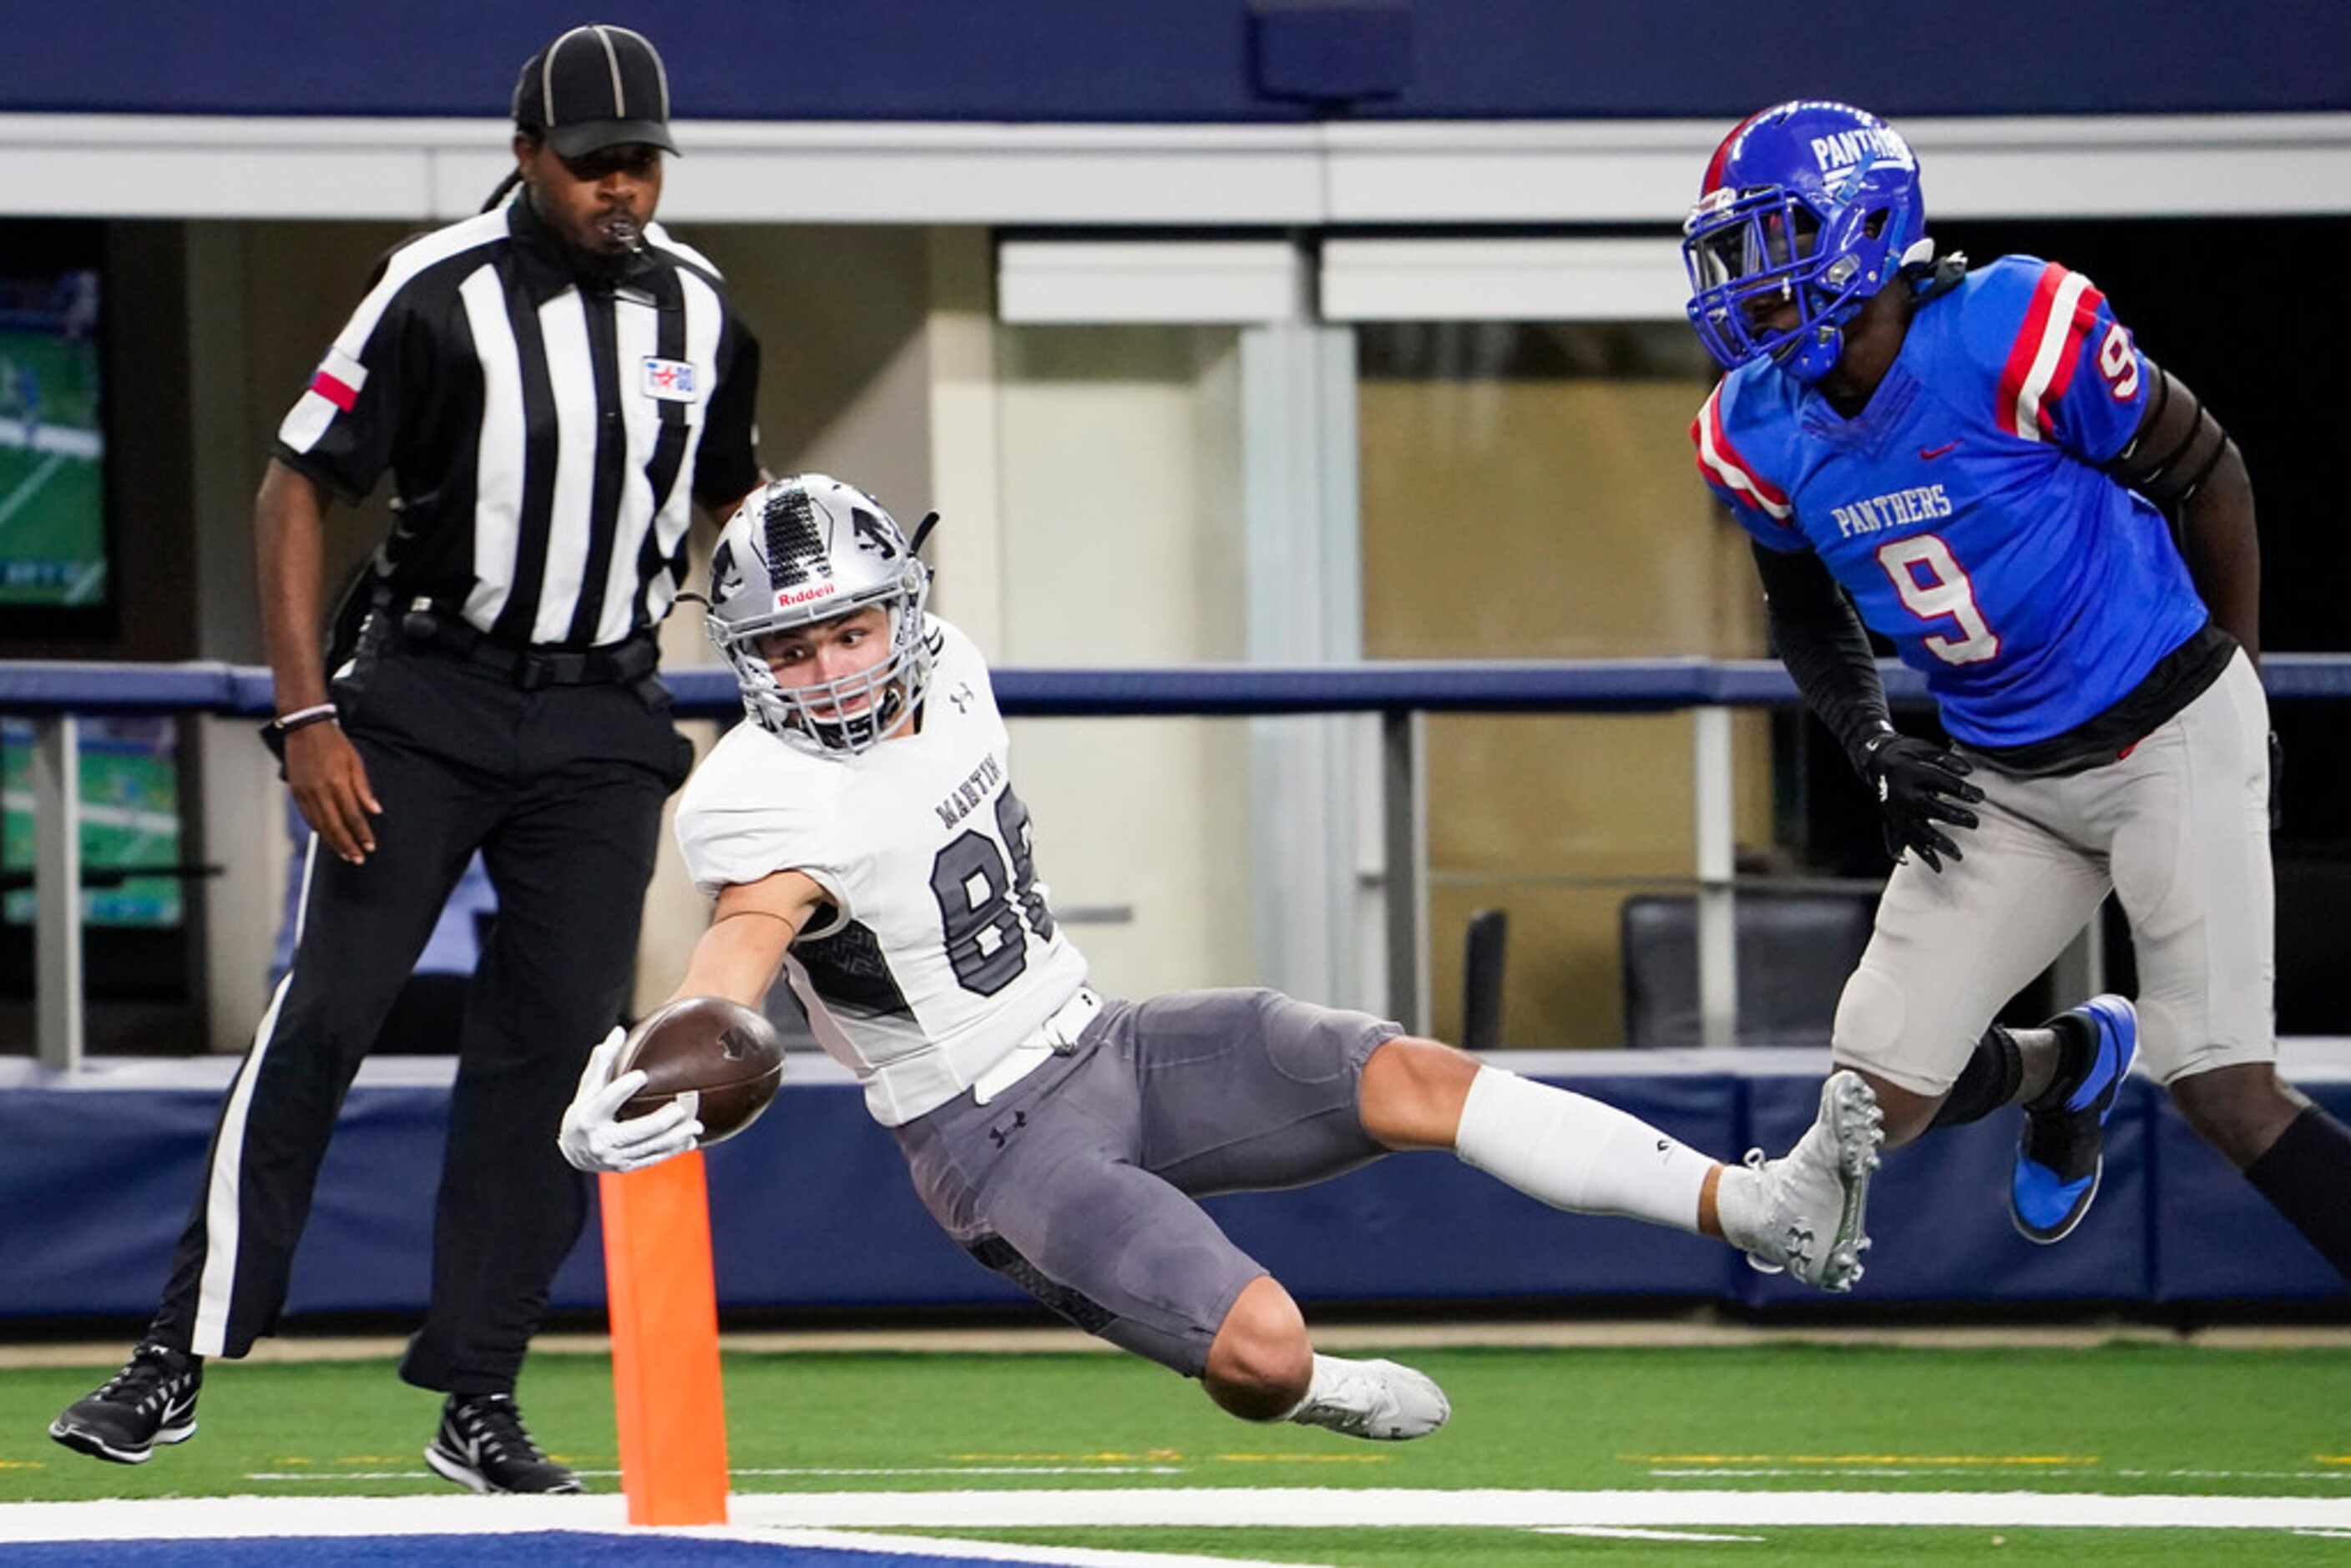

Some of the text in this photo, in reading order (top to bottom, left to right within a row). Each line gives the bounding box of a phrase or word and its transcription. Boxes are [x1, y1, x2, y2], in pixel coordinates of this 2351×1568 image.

[2098, 321, 2138, 401] 9
[1830, 483, 1952, 539] PANTHERS
[778, 584, 834, 607] Riddell
[1876, 532, 2000, 666] 9
[934, 753, 1001, 830] MARTIN
